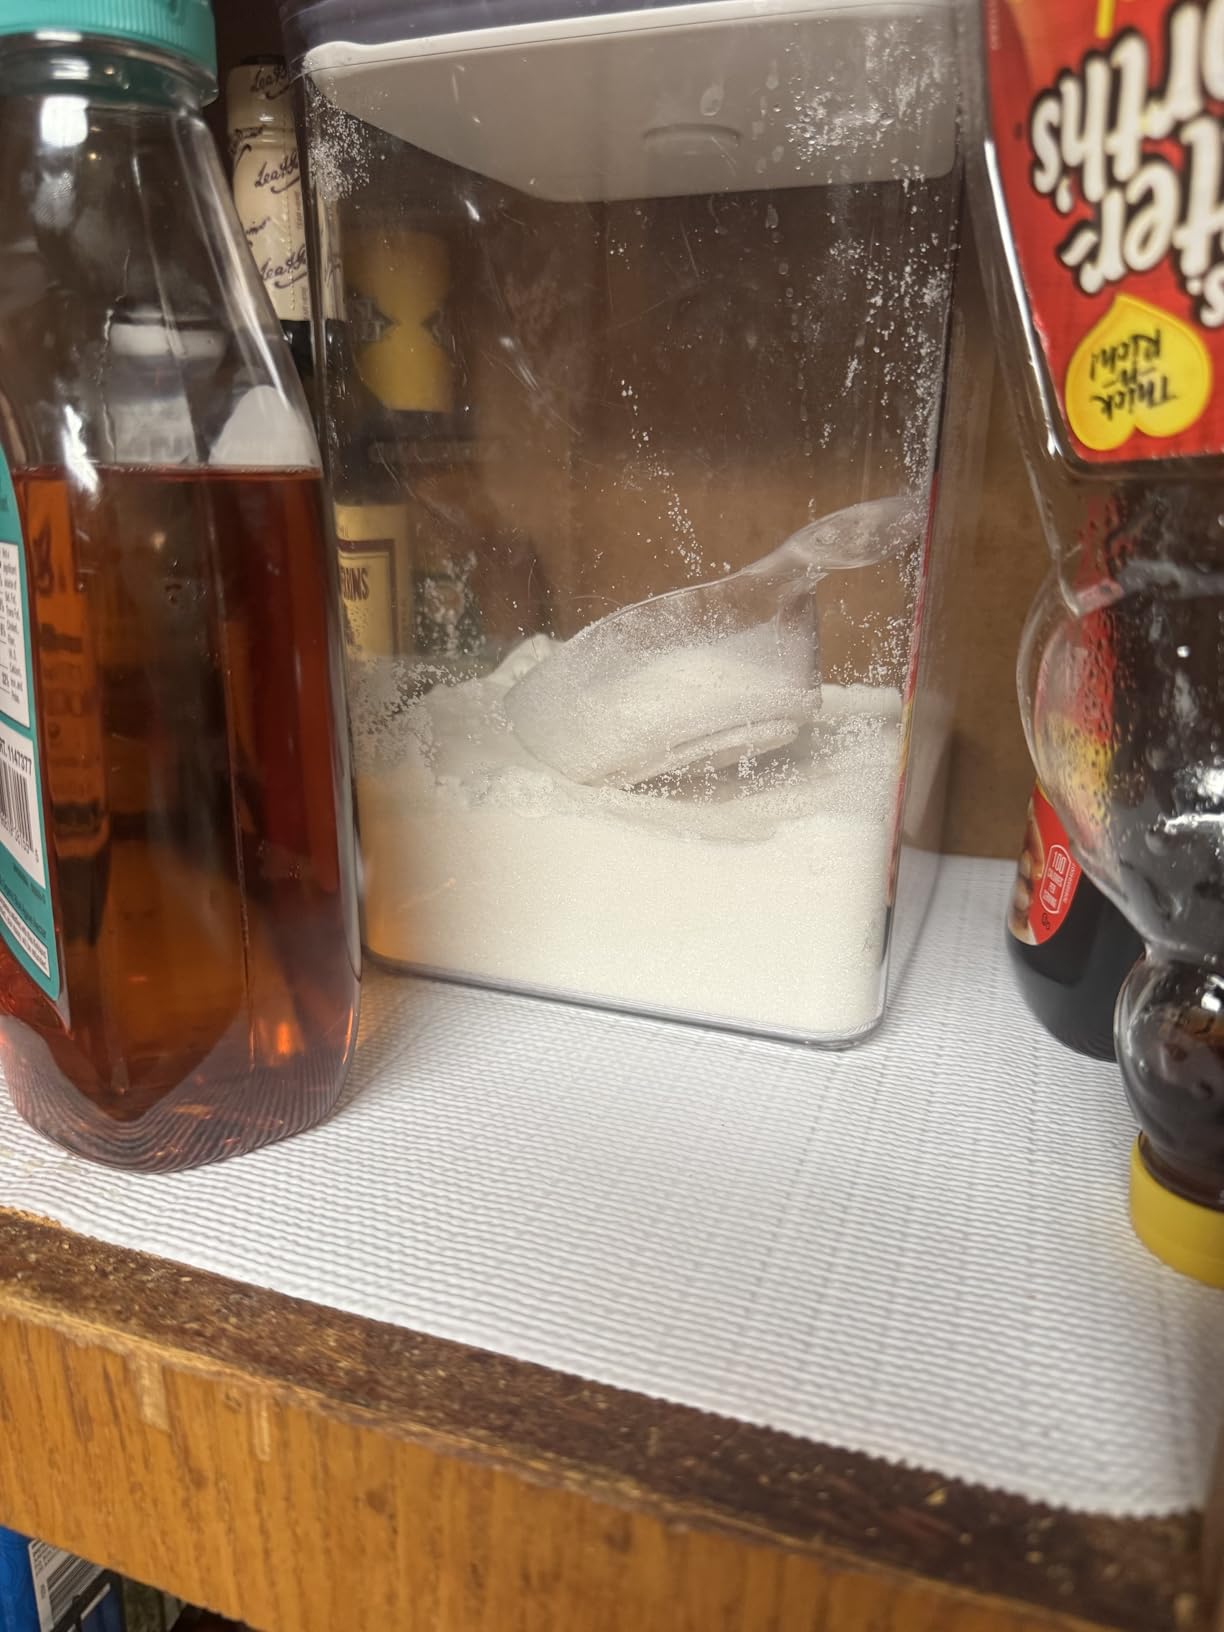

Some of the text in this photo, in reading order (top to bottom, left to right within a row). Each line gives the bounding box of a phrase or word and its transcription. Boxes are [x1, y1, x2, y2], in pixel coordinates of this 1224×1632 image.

[1058, 114, 1224, 295] ter-
[1089, 328, 1161, 382] Rich!
[1089, 375, 1179, 421] Thick
